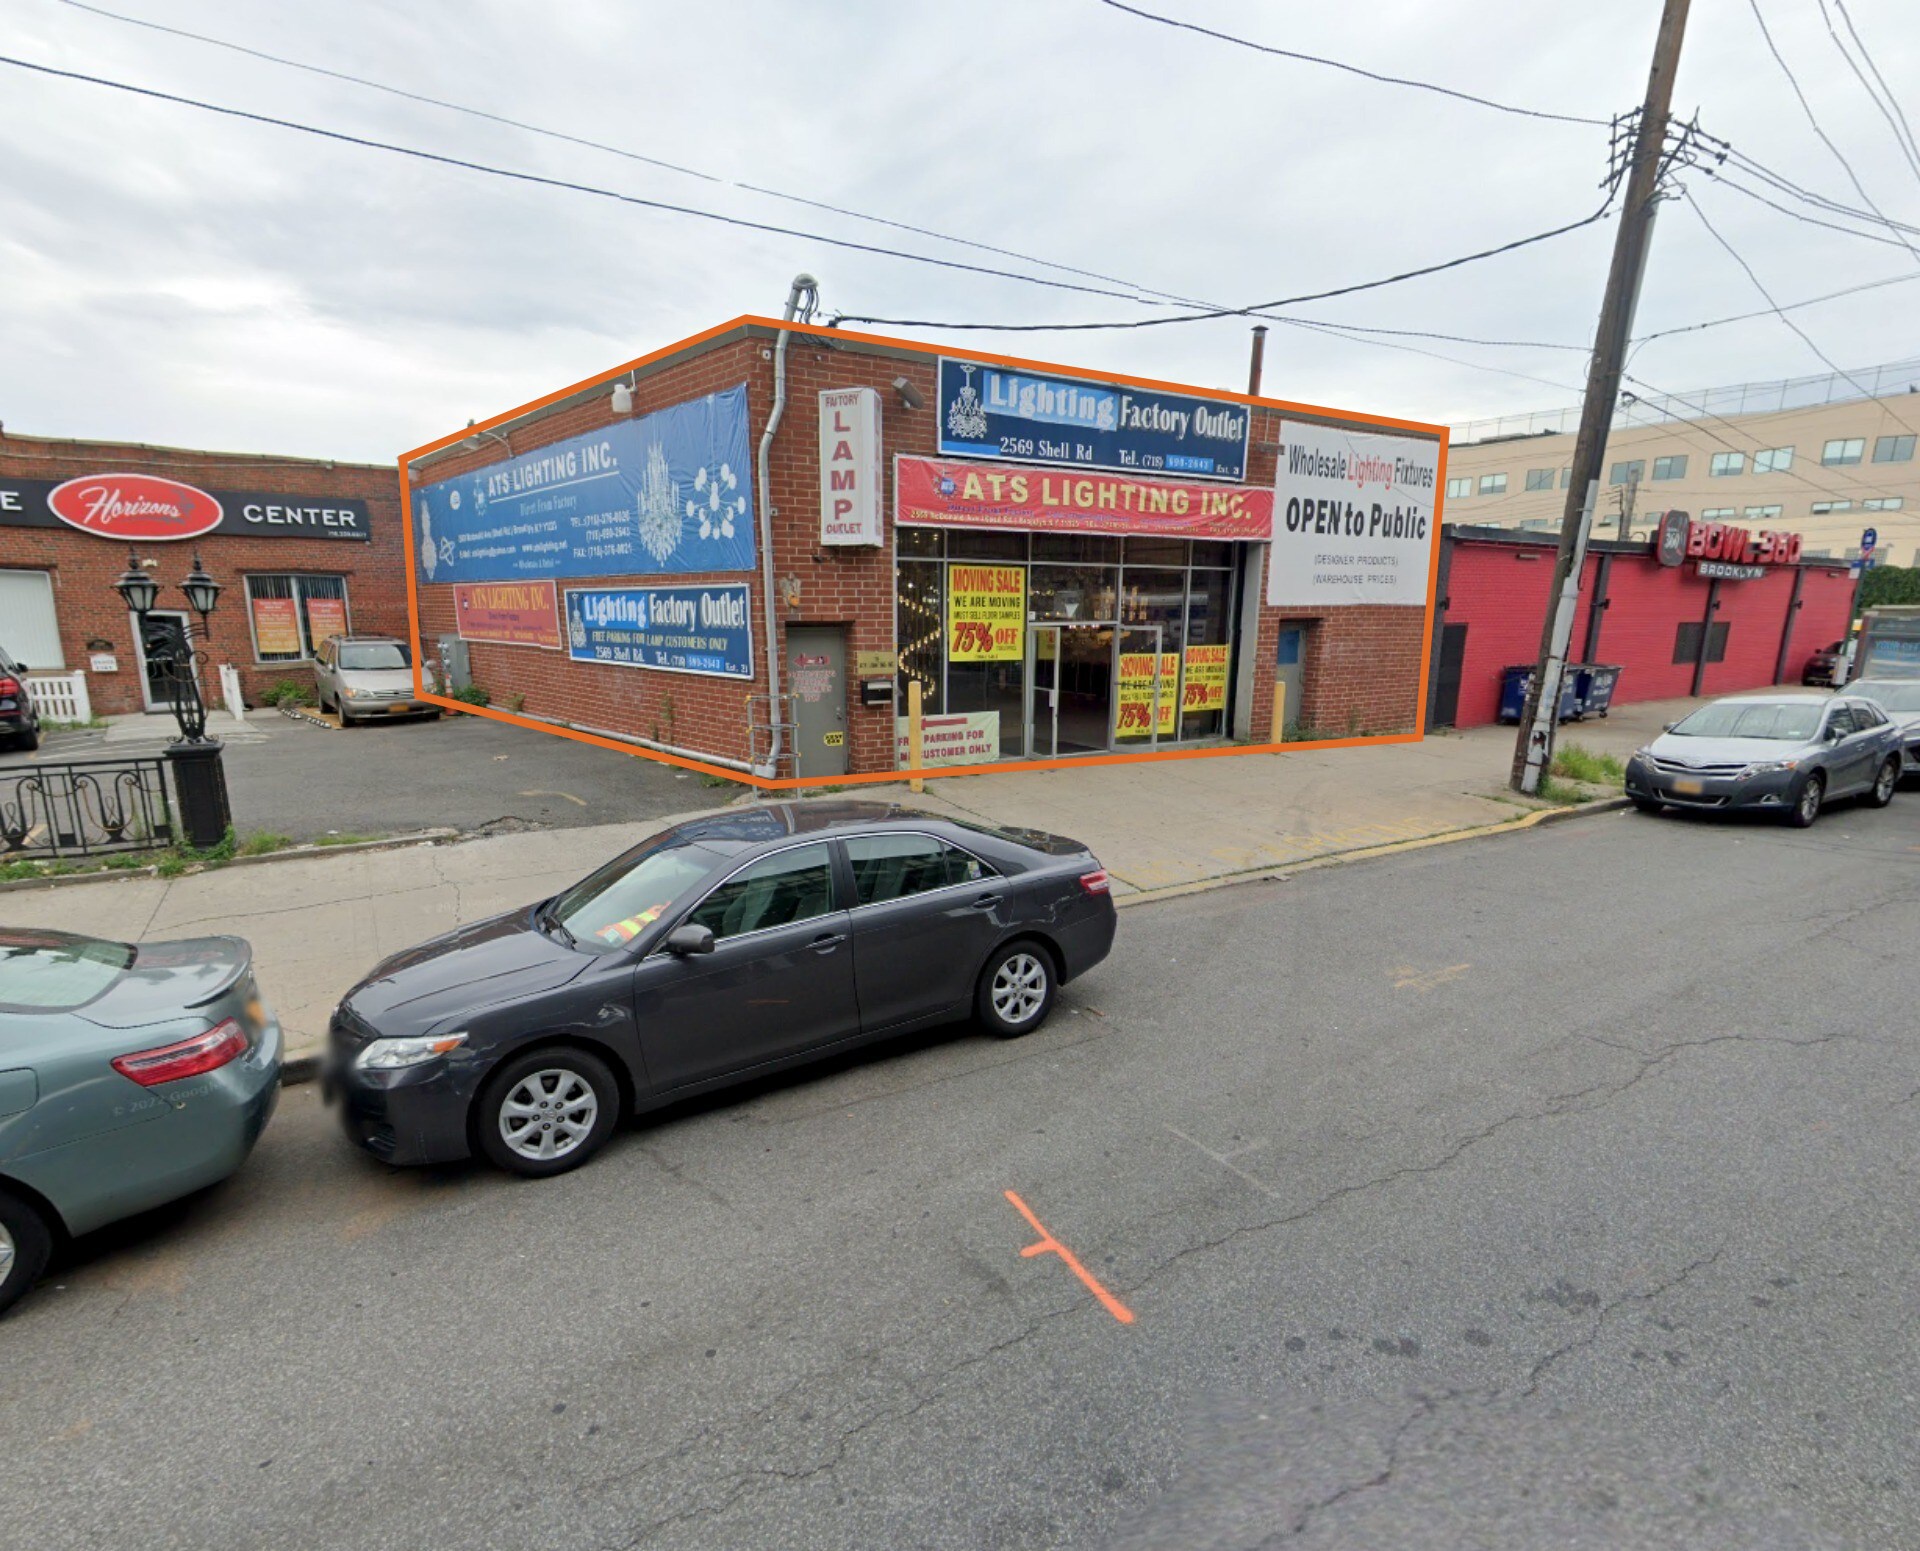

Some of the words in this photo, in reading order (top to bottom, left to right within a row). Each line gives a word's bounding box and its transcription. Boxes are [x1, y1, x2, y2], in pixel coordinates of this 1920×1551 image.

[990, 374, 1114, 430] Lighting
[1121, 395, 1190, 440] Factory
[1195, 406, 1243, 440] Outlet
[1000, 436, 1034, 455] 2569
[1038, 440, 1069, 459] Shell
[1076, 443, 1093, 461] Rd
[1119, 450, 1139, 466] Tel.
[1142, 454, 1164, 470] (718)
[488, 471, 510, 497] ATS
[514, 451, 577, 490] LIGHTING
[582, 441, 617, 473] INC.
[831, 411, 855, 520] LAMP
[1289, 444, 1347, 480] Wholesale
[1348, 453, 1393, 490] Lighting
[1394, 457, 1433, 488] Fixtures
[78, 485, 181, 524] Horizons
[962, 472, 1029, 503] ATS
[1042, 478, 1189, 516] LIGHTING
[1201, 492, 1251, 519] INC.
[243, 504, 357, 527] CENTER
[1286, 497, 1342, 535] OPEN
[1345, 502, 1364, 537] to
[1370, 503, 1426, 540] Public
[826, 523, 862, 534] OUTLET
[1686, 520, 1754, 563] BOWL
[1757, 530, 1803, 564] 360
[1314, 554, 1354, 566] (DESIGNER
[1357, 555, 1399, 567] PRODUCTS)
[1700, 563, 1763, 578] BROOKLYN
[953, 568, 994, 593] MOVING
[996, 570, 1021, 593] SALE
[1313, 574, 1363, 584] (WAREHOUSE
[1367, 574, 1397, 585] PRICES)
[488, 587, 530, 610] LIGHTING
[954, 596, 967, 607] WE
[969, 596, 987, 607] ARE
[989, 596, 1020, 608] MOVING
[583, 594, 646, 628] Lighting
[650, 593, 697, 632] Factory
[701, 591, 745, 627] Outlet
[954, 611, 968, 620] MUST
[999, 611, 1020, 620] SAMPLES
[592, 631, 606, 642] FREE
[607, 632, 631, 644] PARKING
[633, 632, 645, 644] FOR
[646, 634, 664, 646] LAMP
[665, 636, 707, 650] CUSTOMERS
[709, 637, 728, 651] ONLY
[952, 621, 994, 653] 75%
[995, 628, 1018, 645] OFF
[596, 646, 612, 659] 2569
[655, 651, 669, 666] Tel.
[1120, 656, 1154, 678] MOVING
[1160, 656, 1176, 677] ALE
[1185, 648, 1210, 665] MOVING
[1211, 647, 1226, 663] SALE
[1182, 682, 1208, 706] 75%
[1208, 685, 1223, 699] OFF
[1116, 702, 1151, 729] 75%
[924, 731, 964, 744] PARKING
[966, 730, 984, 740] FOR
[969, 743, 992, 755] ONLY
